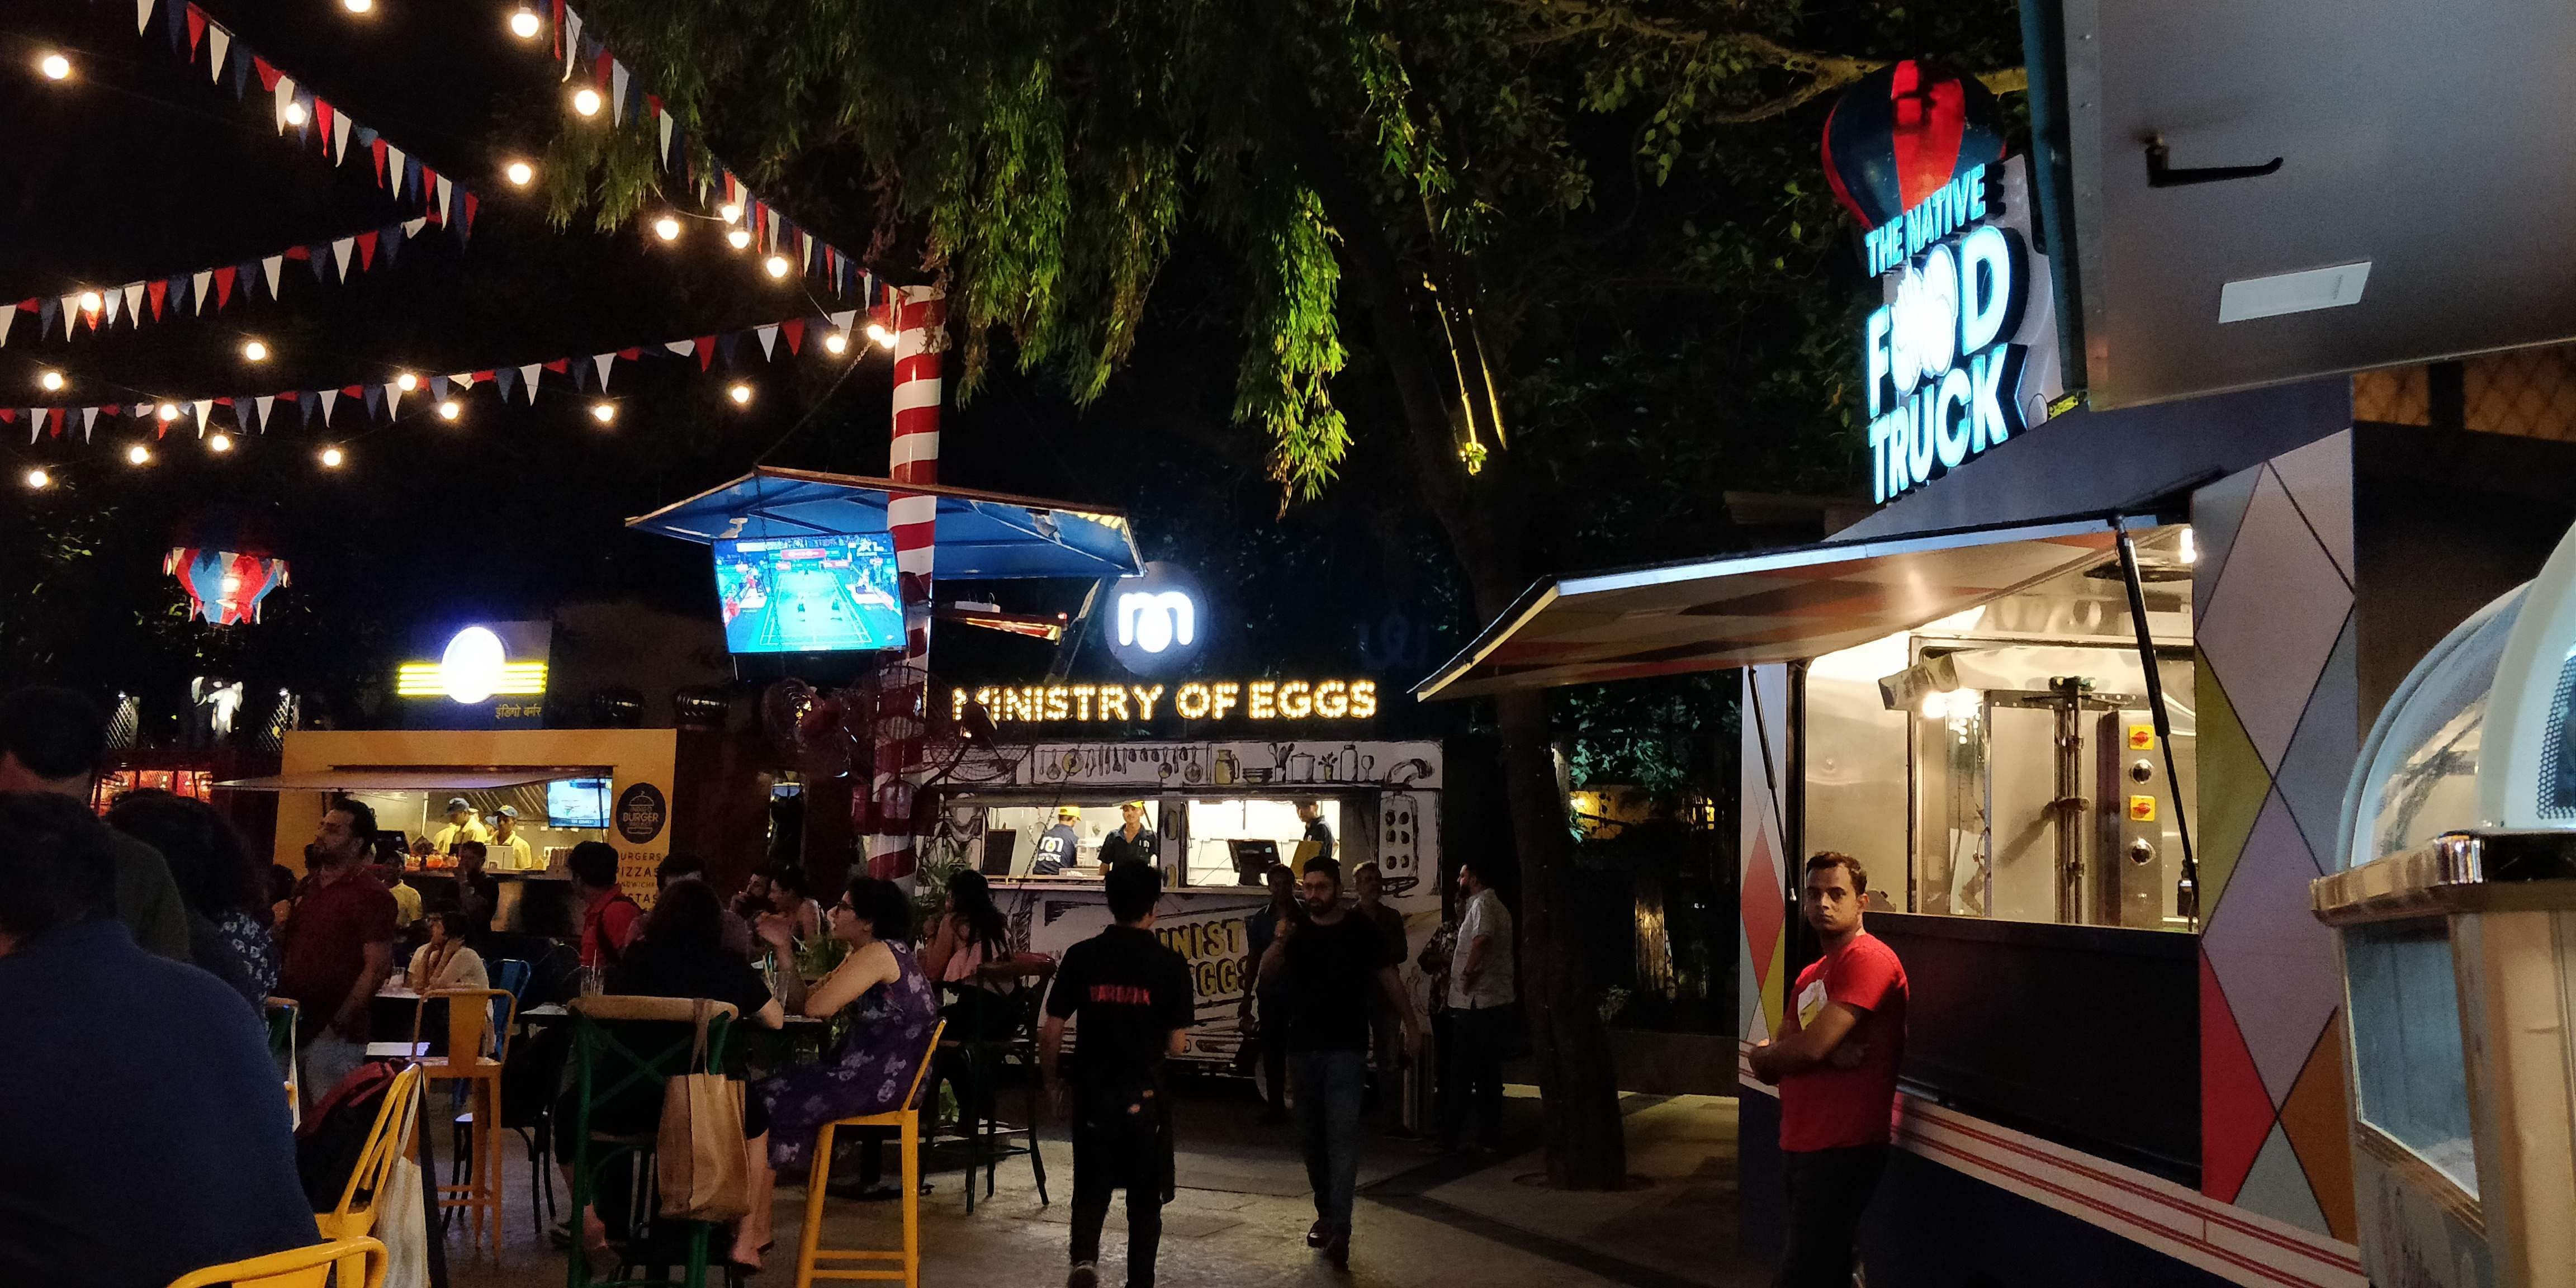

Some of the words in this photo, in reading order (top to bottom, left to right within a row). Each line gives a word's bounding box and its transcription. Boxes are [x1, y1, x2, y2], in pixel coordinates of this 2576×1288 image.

[1865, 212, 1904, 278] THE
[1906, 162, 1986, 258] NATIVE
[1868, 342, 2008, 504] TRUCK
[1176, 681, 1239, 721] OF
[1248, 680, 1377, 721] EGGS
[622, 812, 659, 822] BURGER
[616, 866, 658, 877] IZZAS
[620, 853, 661, 861] URGERS
[1156, 918, 1246, 960] INIST
